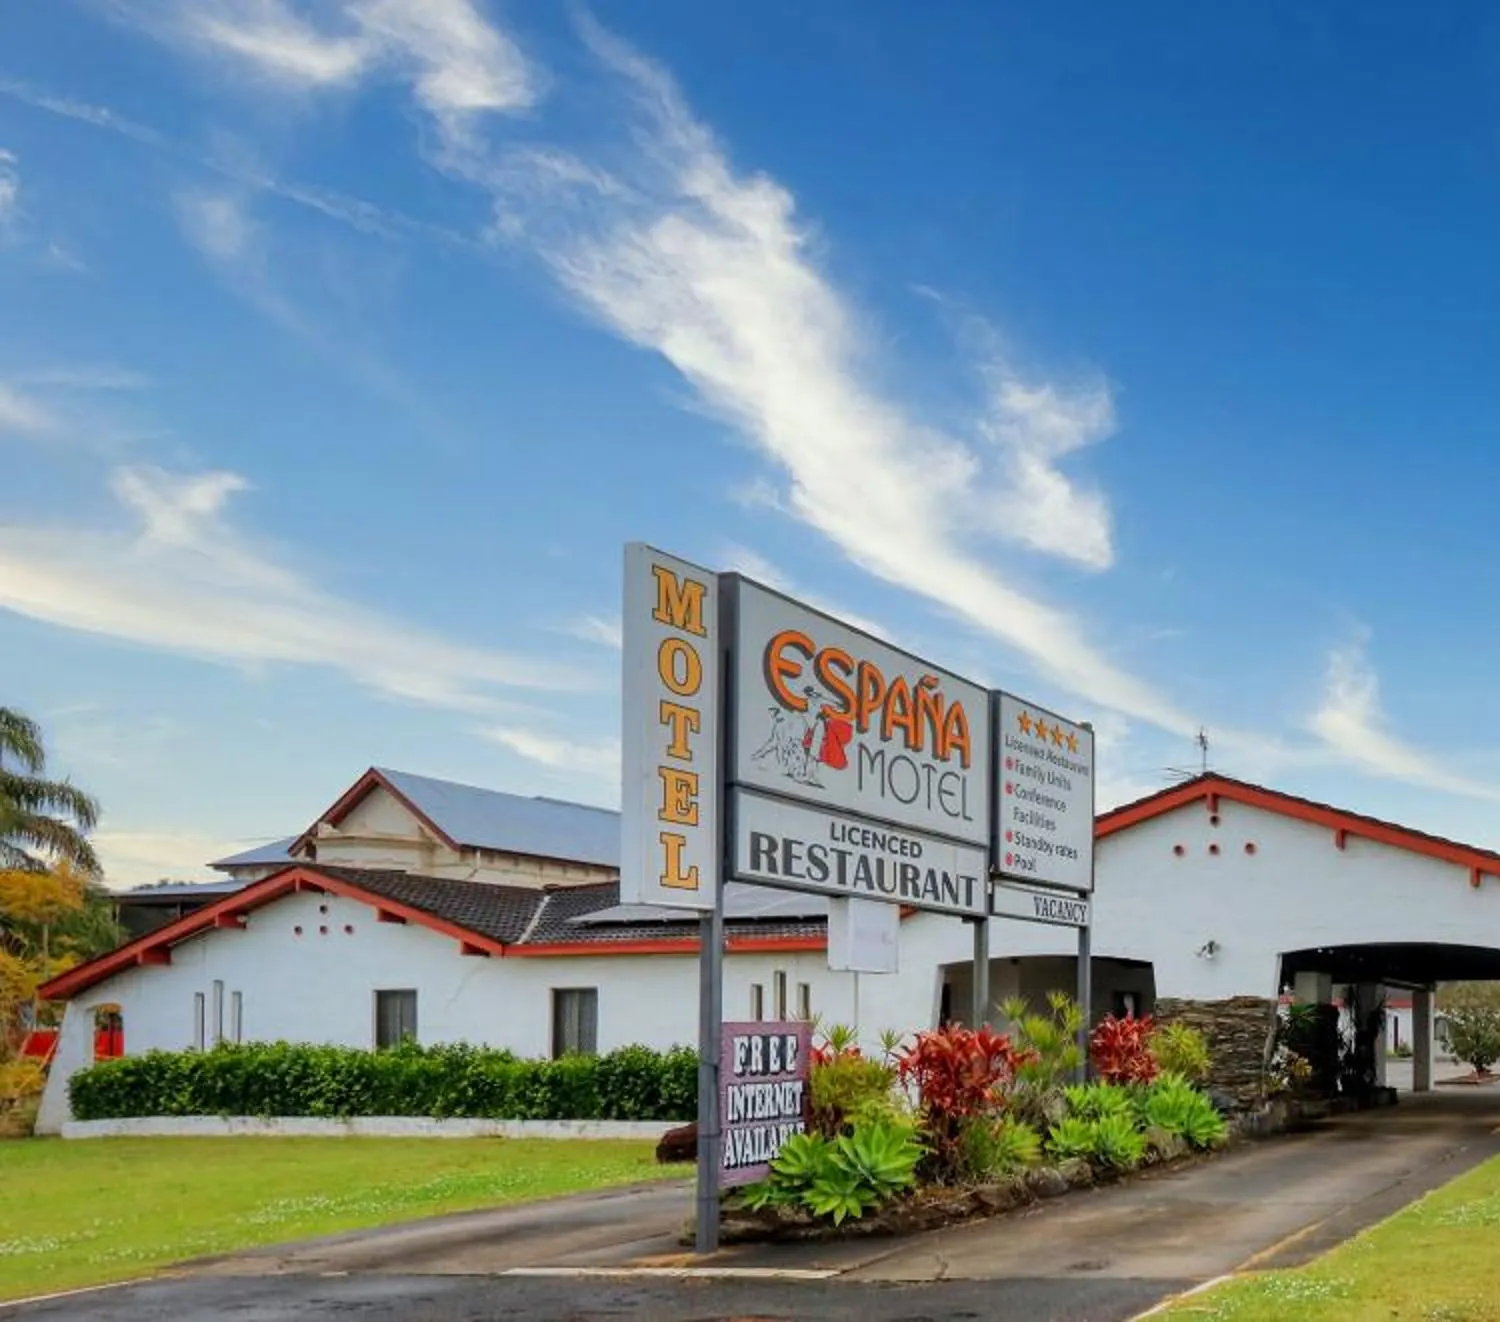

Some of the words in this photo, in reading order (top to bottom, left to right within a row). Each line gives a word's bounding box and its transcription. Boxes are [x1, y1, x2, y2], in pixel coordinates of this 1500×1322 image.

[763, 630, 971, 768] ESPAÑA
[652, 564, 706, 890] MOTEL
[858, 743, 973, 822] MOTEL
[1015, 759, 1044, 784] Family
[1047, 771, 1071, 791] Units
[1015, 784, 1067, 812] Conference
[1012, 806, 1056, 831] Facilities
[830, 822, 923, 859] LICENCED
[1015, 832, 1054, 856] Standby
[1055, 845, 1078, 860] rates
[750, 831, 978, 907] RESTAURANT
[1015, 853, 1036, 871] Pool
[1033, 896, 1087, 922] VACANCY
[732, 1035, 798, 1075] FREE
[727, 1082, 803, 1121] INTERNET
